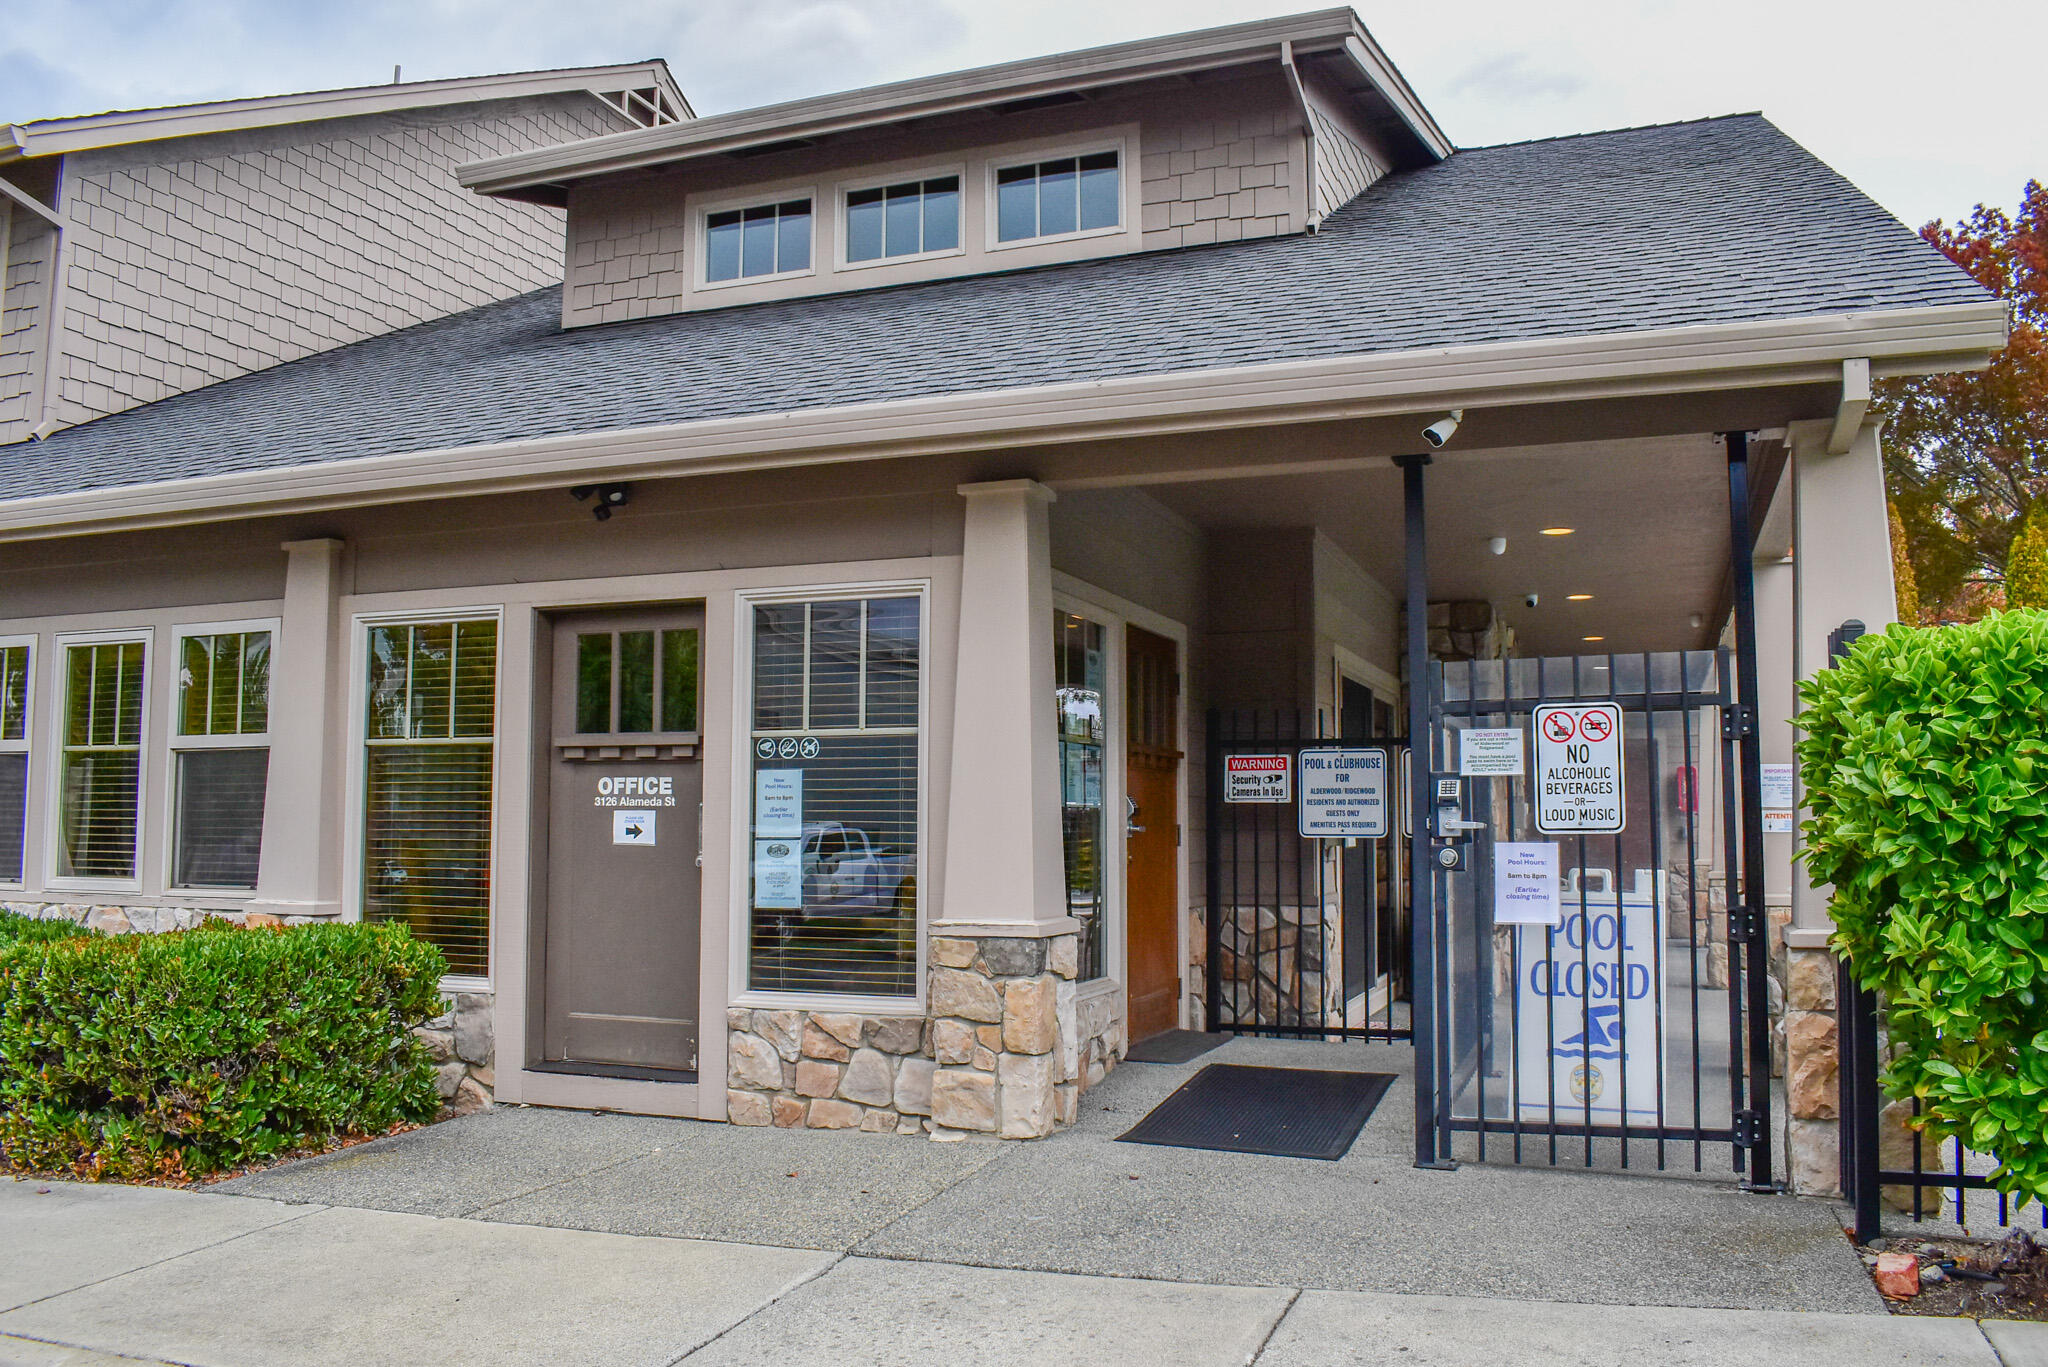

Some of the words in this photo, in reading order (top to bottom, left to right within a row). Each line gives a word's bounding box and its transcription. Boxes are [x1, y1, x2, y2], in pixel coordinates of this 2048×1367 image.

[1567, 744, 1590, 764] NO
[1231, 759, 1284, 770] WARNING
[1304, 758, 1326, 769] POOL
[1328, 760, 1332, 769] &
[1334, 758, 1381, 768] CLUBHOUSE
[1336, 774, 1350, 782] FOR
[1548, 766, 1611, 780] ALCOHOLIC
[598, 776, 672, 795] OFFICE
[1232, 774, 1261, 786] Security
[1232, 787, 1260, 796] Cameras
[1263, 787, 1270, 796] In
[1271, 786, 1283, 796] Use
[1546, 782, 1613, 795] BEVERAGES
[594, 796, 618, 806] 3126
[619, 796, 662, 806] Alameda
[664, 796, 676, 806] St
[1575, 798, 1586, 806] OR
[1545, 809, 1575, 821] LOUD
[1580, 808, 1615, 820] MUSIC
[1530, 960, 1650, 1000] CLOSED
